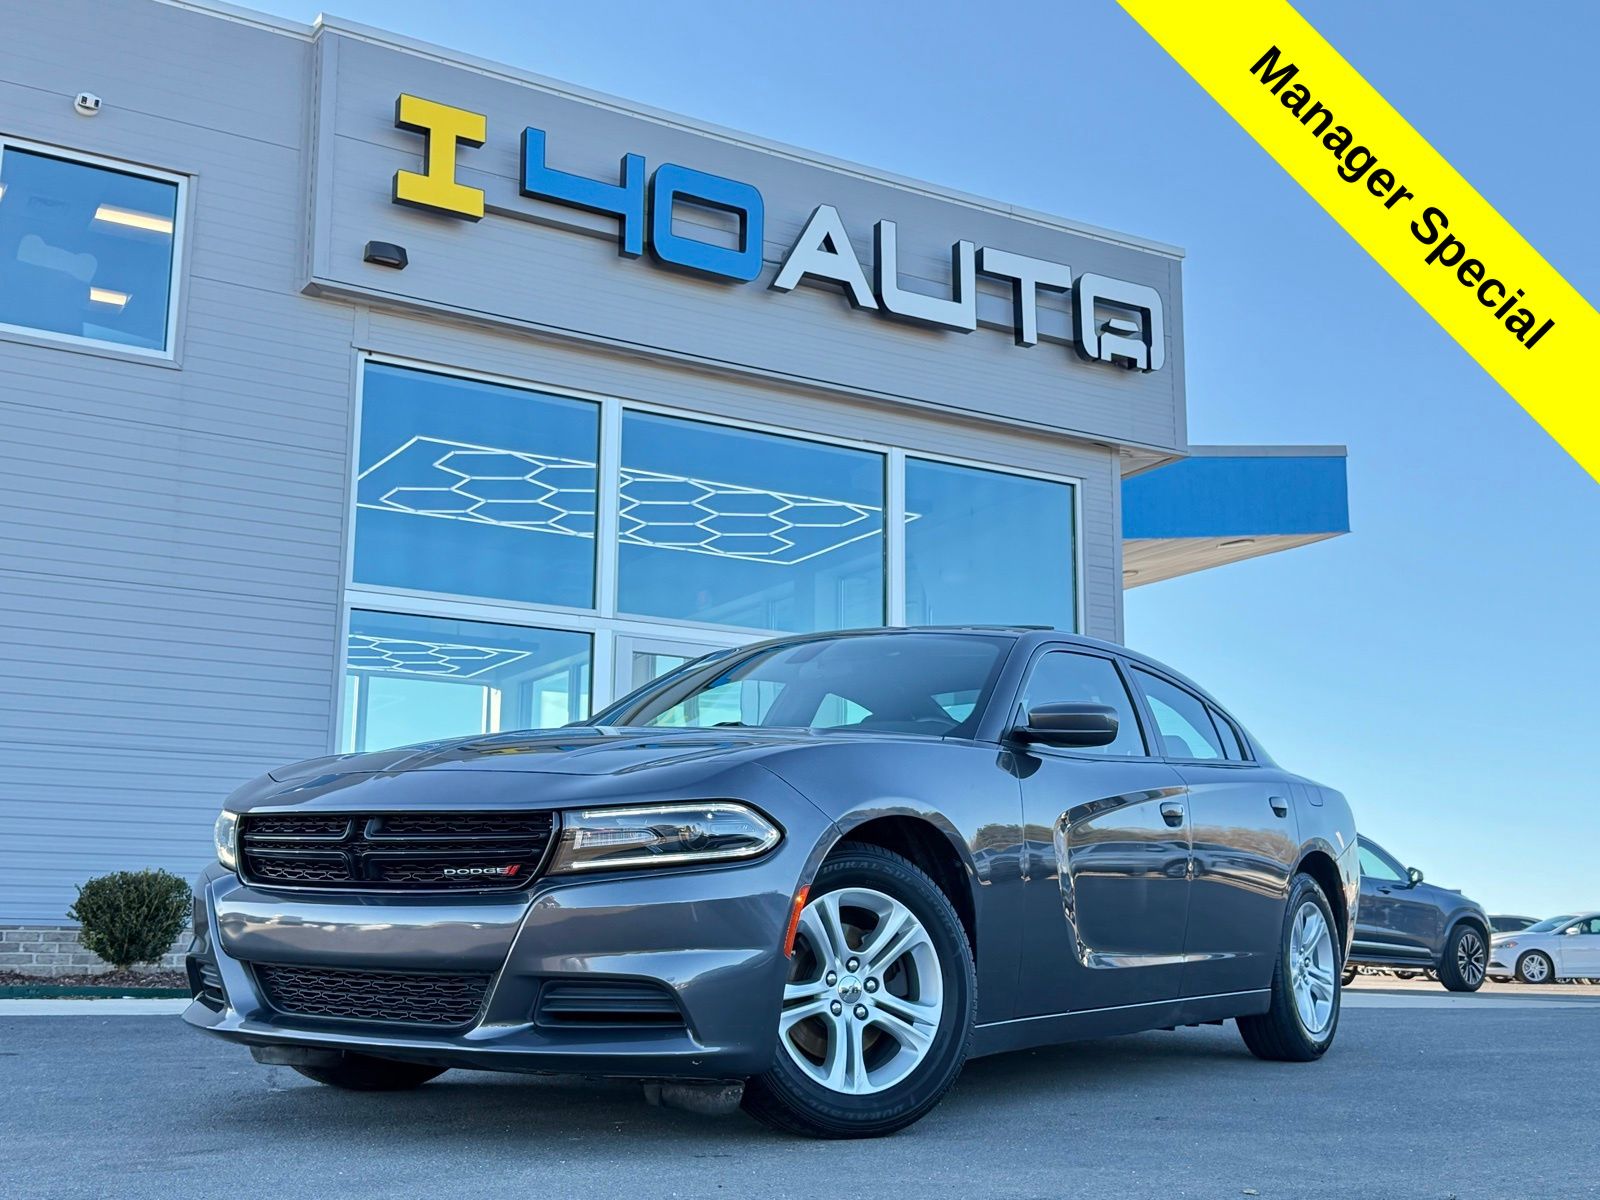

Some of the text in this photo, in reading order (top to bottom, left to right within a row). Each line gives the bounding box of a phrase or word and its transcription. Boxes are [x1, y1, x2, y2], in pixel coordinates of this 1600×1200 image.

[393, 92, 488, 223] I
[519, 126, 764, 284] 40
[443, 867, 510, 875] DODGE
